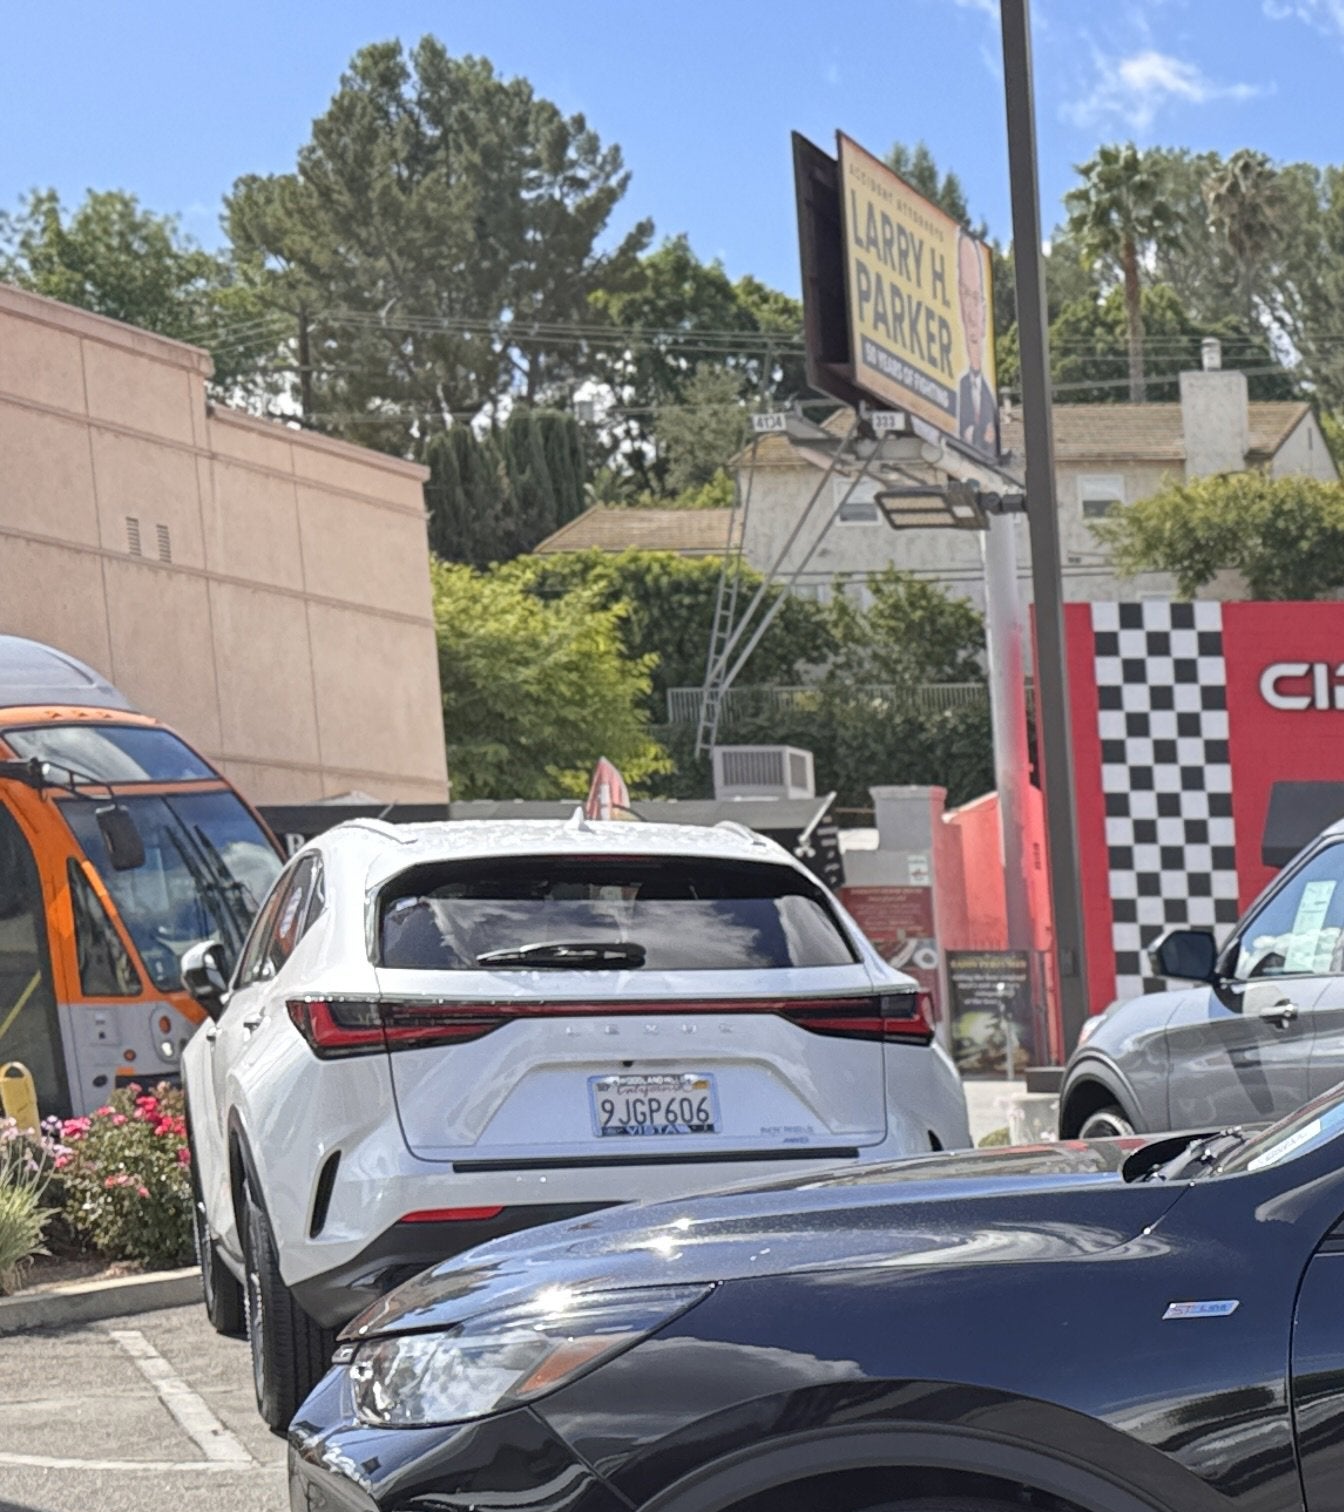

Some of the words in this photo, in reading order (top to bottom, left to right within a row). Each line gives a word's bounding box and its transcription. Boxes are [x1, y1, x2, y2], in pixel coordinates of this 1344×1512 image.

[851, 188, 924, 288] LARRY
[856, 258, 955, 380] PARKER
[565, 1024, 734, 1035] LEXUS
[601, 1096, 710, 1127] 9JGP606
